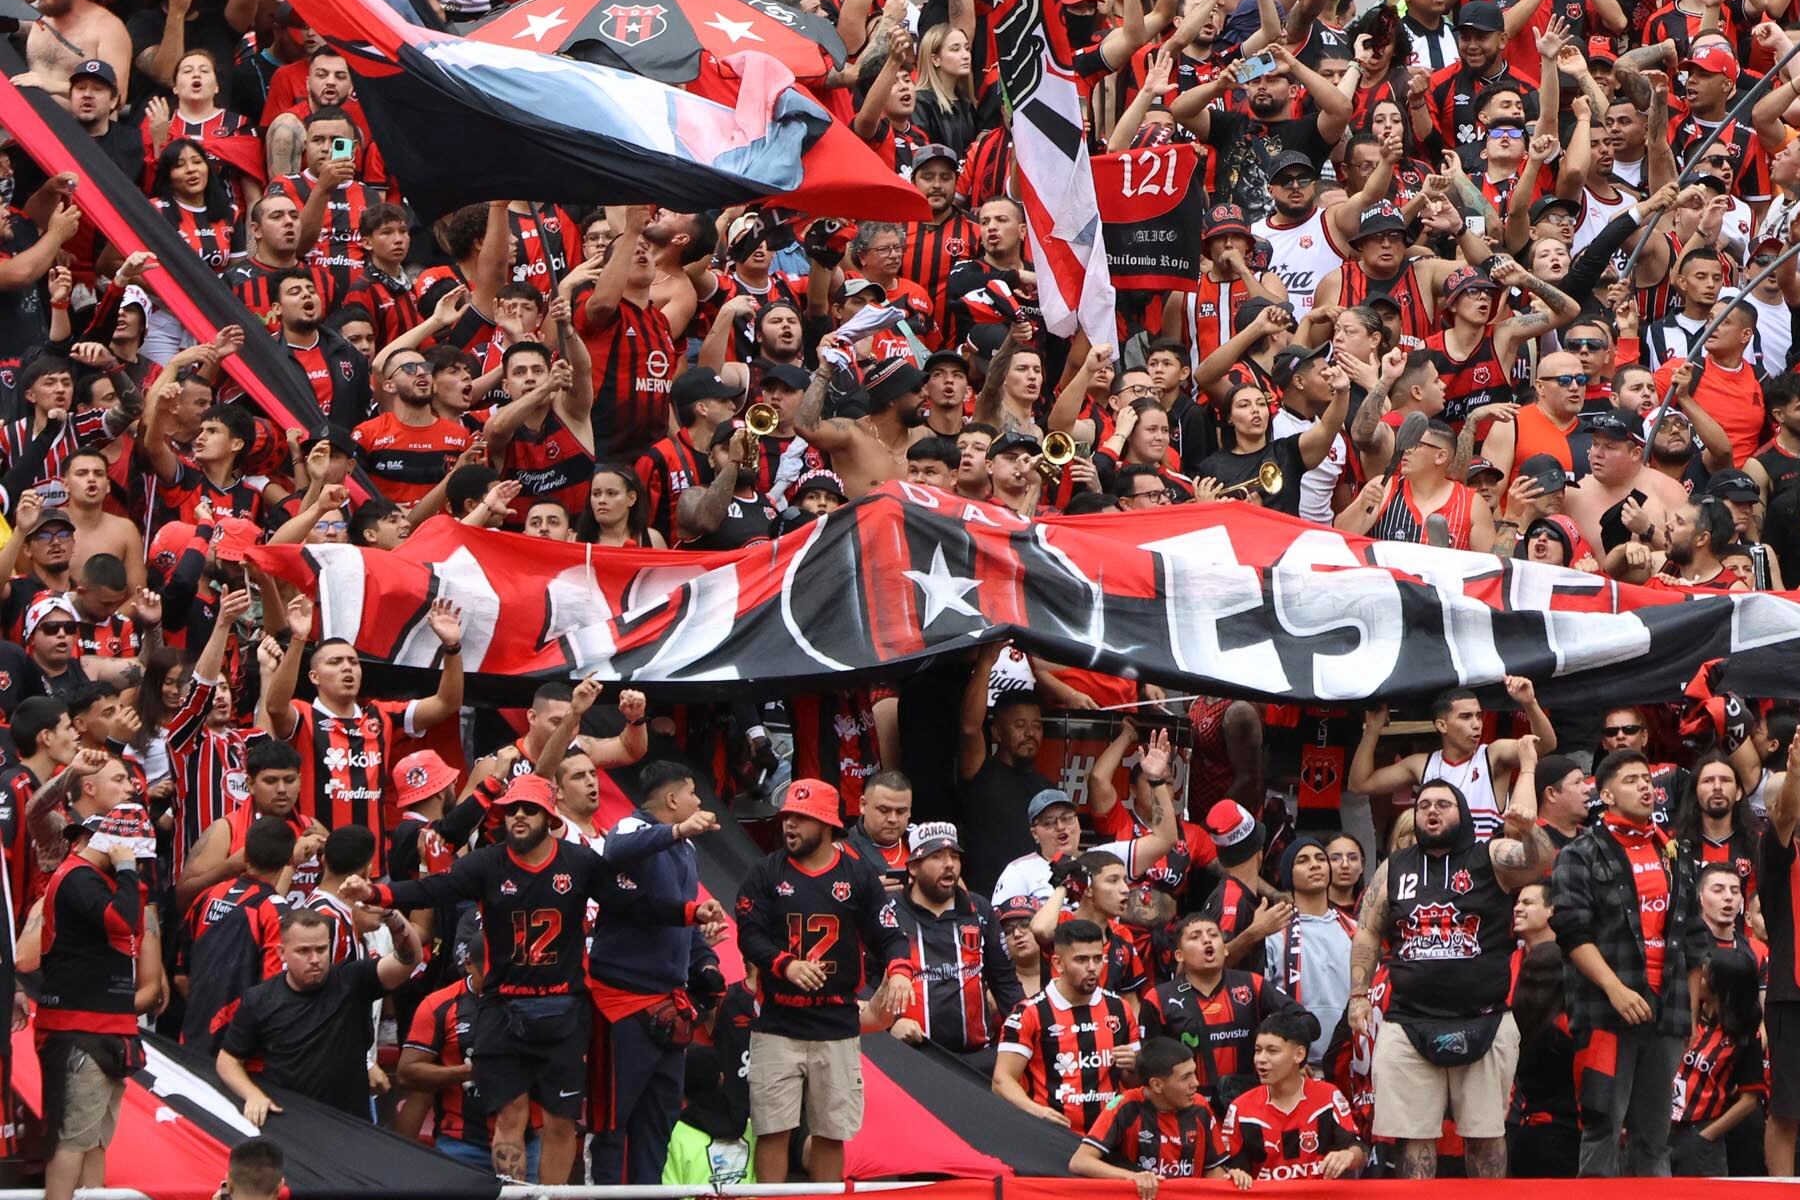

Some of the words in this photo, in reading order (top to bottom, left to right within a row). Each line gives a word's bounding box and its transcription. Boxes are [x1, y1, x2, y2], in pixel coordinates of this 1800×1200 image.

[1119, 148, 1177, 197] 121
[526, 260, 566, 277] köbi
[1160, 255, 1190, 270] Rojo
[1201, 304, 1214, 312] 12
[636, 378, 673, 393] MERIV
[216, 507, 233, 516] BAC
[1138, 523, 1652, 700] ESTE
[513, 760, 531, 775] 08
[1399, 874, 1418, 899] 12
[1420, 908, 1452, 919] L.D.A
[513, 909, 562, 965] 12
[787, 914, 840, 974] 12
[1082, 1023, 1098, 1031] BAC
[1210, 1028, 1250, 1040] movistar
[1683, 1051, 1715, 1073] ölbi
[1159, 1158, 1193, 1176] kölbi
[1257, 1163, 1322, 1181] SONY
